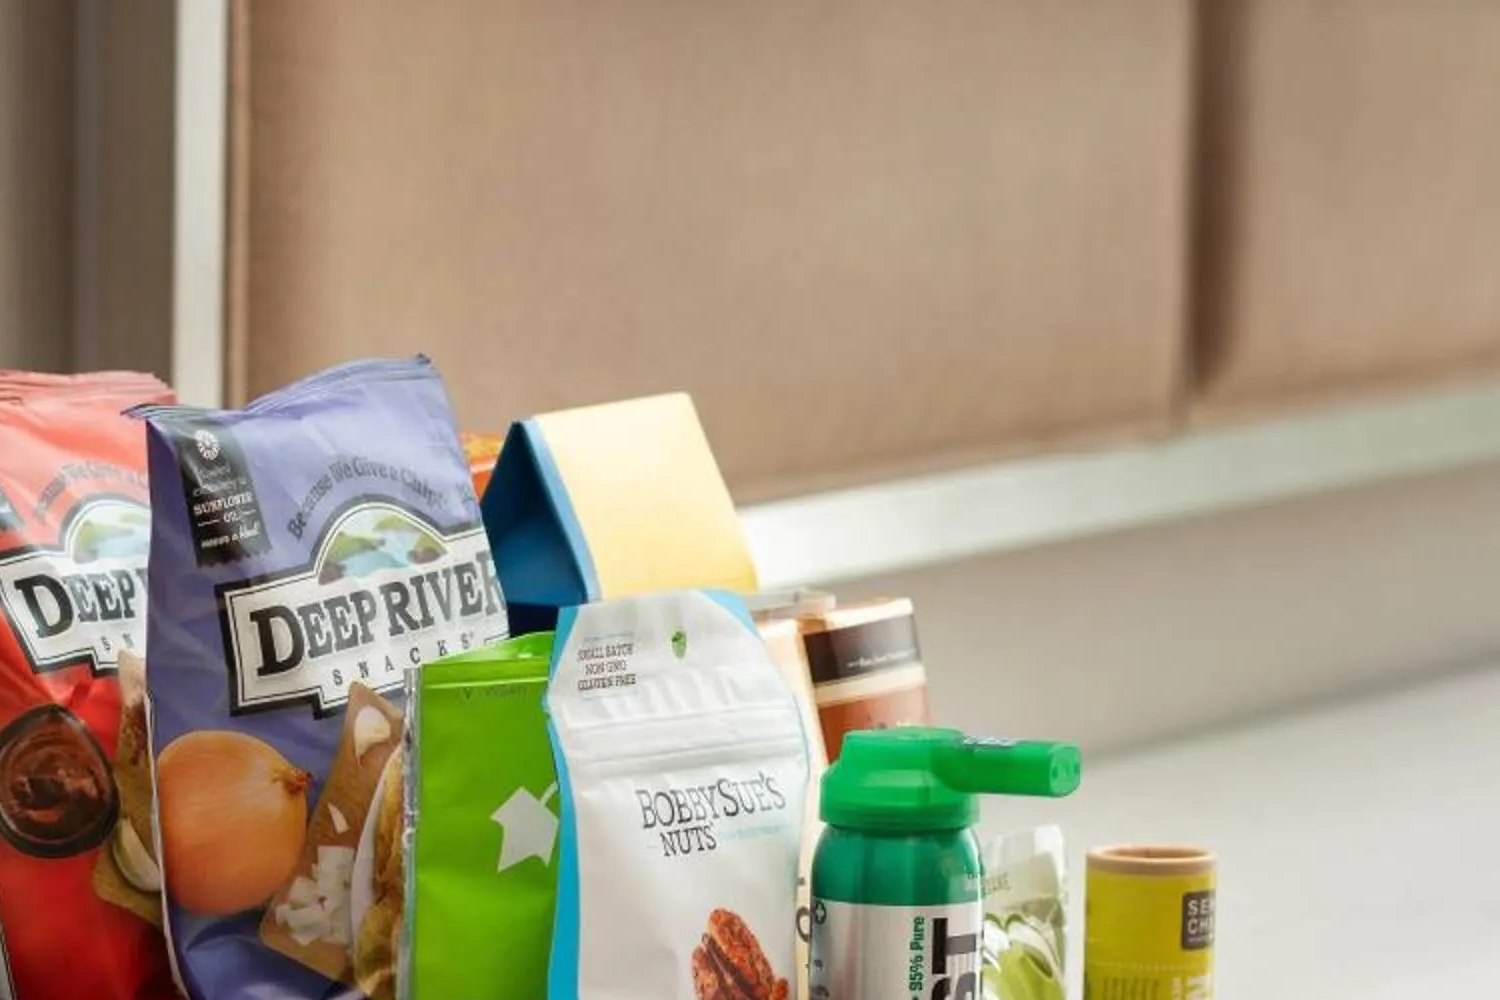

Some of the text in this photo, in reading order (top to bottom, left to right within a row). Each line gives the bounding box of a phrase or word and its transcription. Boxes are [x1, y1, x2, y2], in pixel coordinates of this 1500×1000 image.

[14, 569, 136, 639] DEEP
[249, 589, 377, 677] DEEP
[332, 632, 470, 686] SNACKS
[659, 825, 718, 858] NUTS
[910, 916, 925, 950] Pure
[909, 953, 924, 991] 95%
